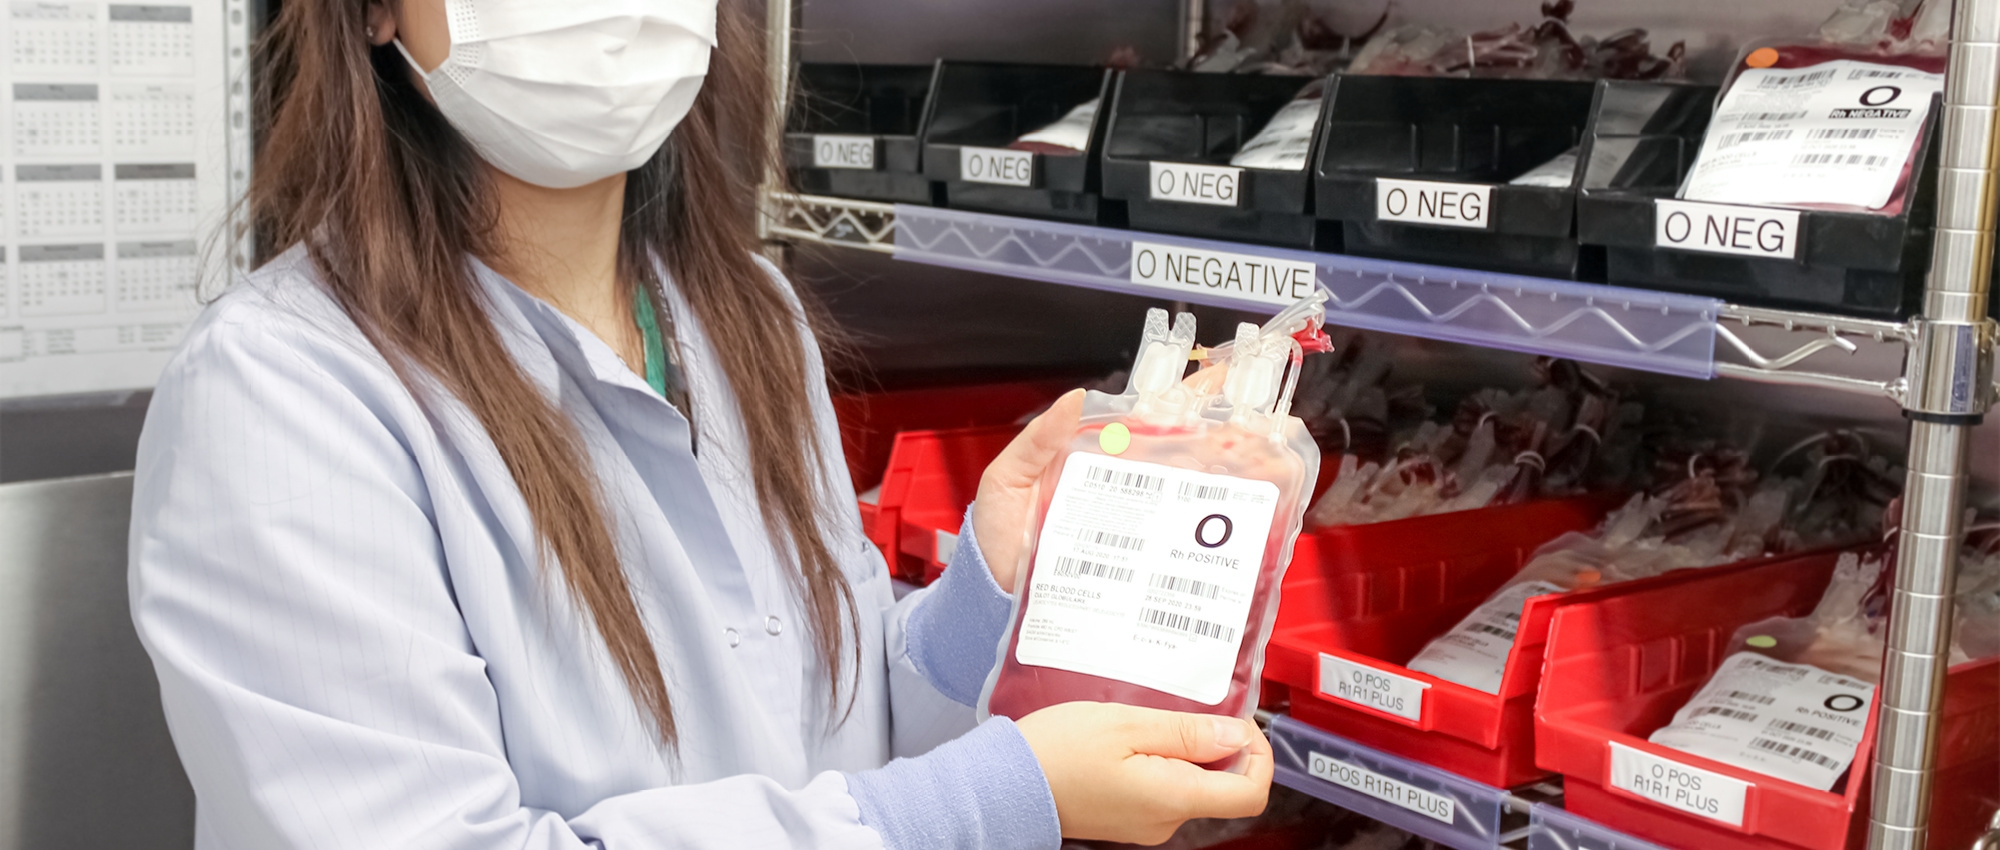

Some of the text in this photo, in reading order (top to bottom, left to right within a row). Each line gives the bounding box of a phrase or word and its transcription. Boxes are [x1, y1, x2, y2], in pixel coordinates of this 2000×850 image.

[1859, 85, 1901, 106] O
[1831, 109, 1909, 119] Rh NEGATIVE
[821, 142, 872, 165] O NEG
[969, 154, 1030, 181] O NEG
[1158, 169, 1233, 200] O NEG
[1386, 188, 1481, 221] O NEG
[1665, 211, 1785, 252] O NEG
[1137, 249, 1310, 299] O NEGATIVE
[1195, 513, 1233, 548] O
[1170, 549, 1240, 570] Rh POSITIVE
[1036, 583, 1101, 599] RED BLOOD CELLS
[1353, 670, 1391, 692] O POS
[1339, 681, 1404, 711] R1R1 PLUS
[1823, 694, 1864, 712] O
[1811, 710, 1861, 726] POSITIVE
[1314, 758, 1448, 817] O POS R1R1 PLUS
[1652, 764, 1701, 791] O POS
[1634, 774, 1719, 814] R1R1 PLUS
